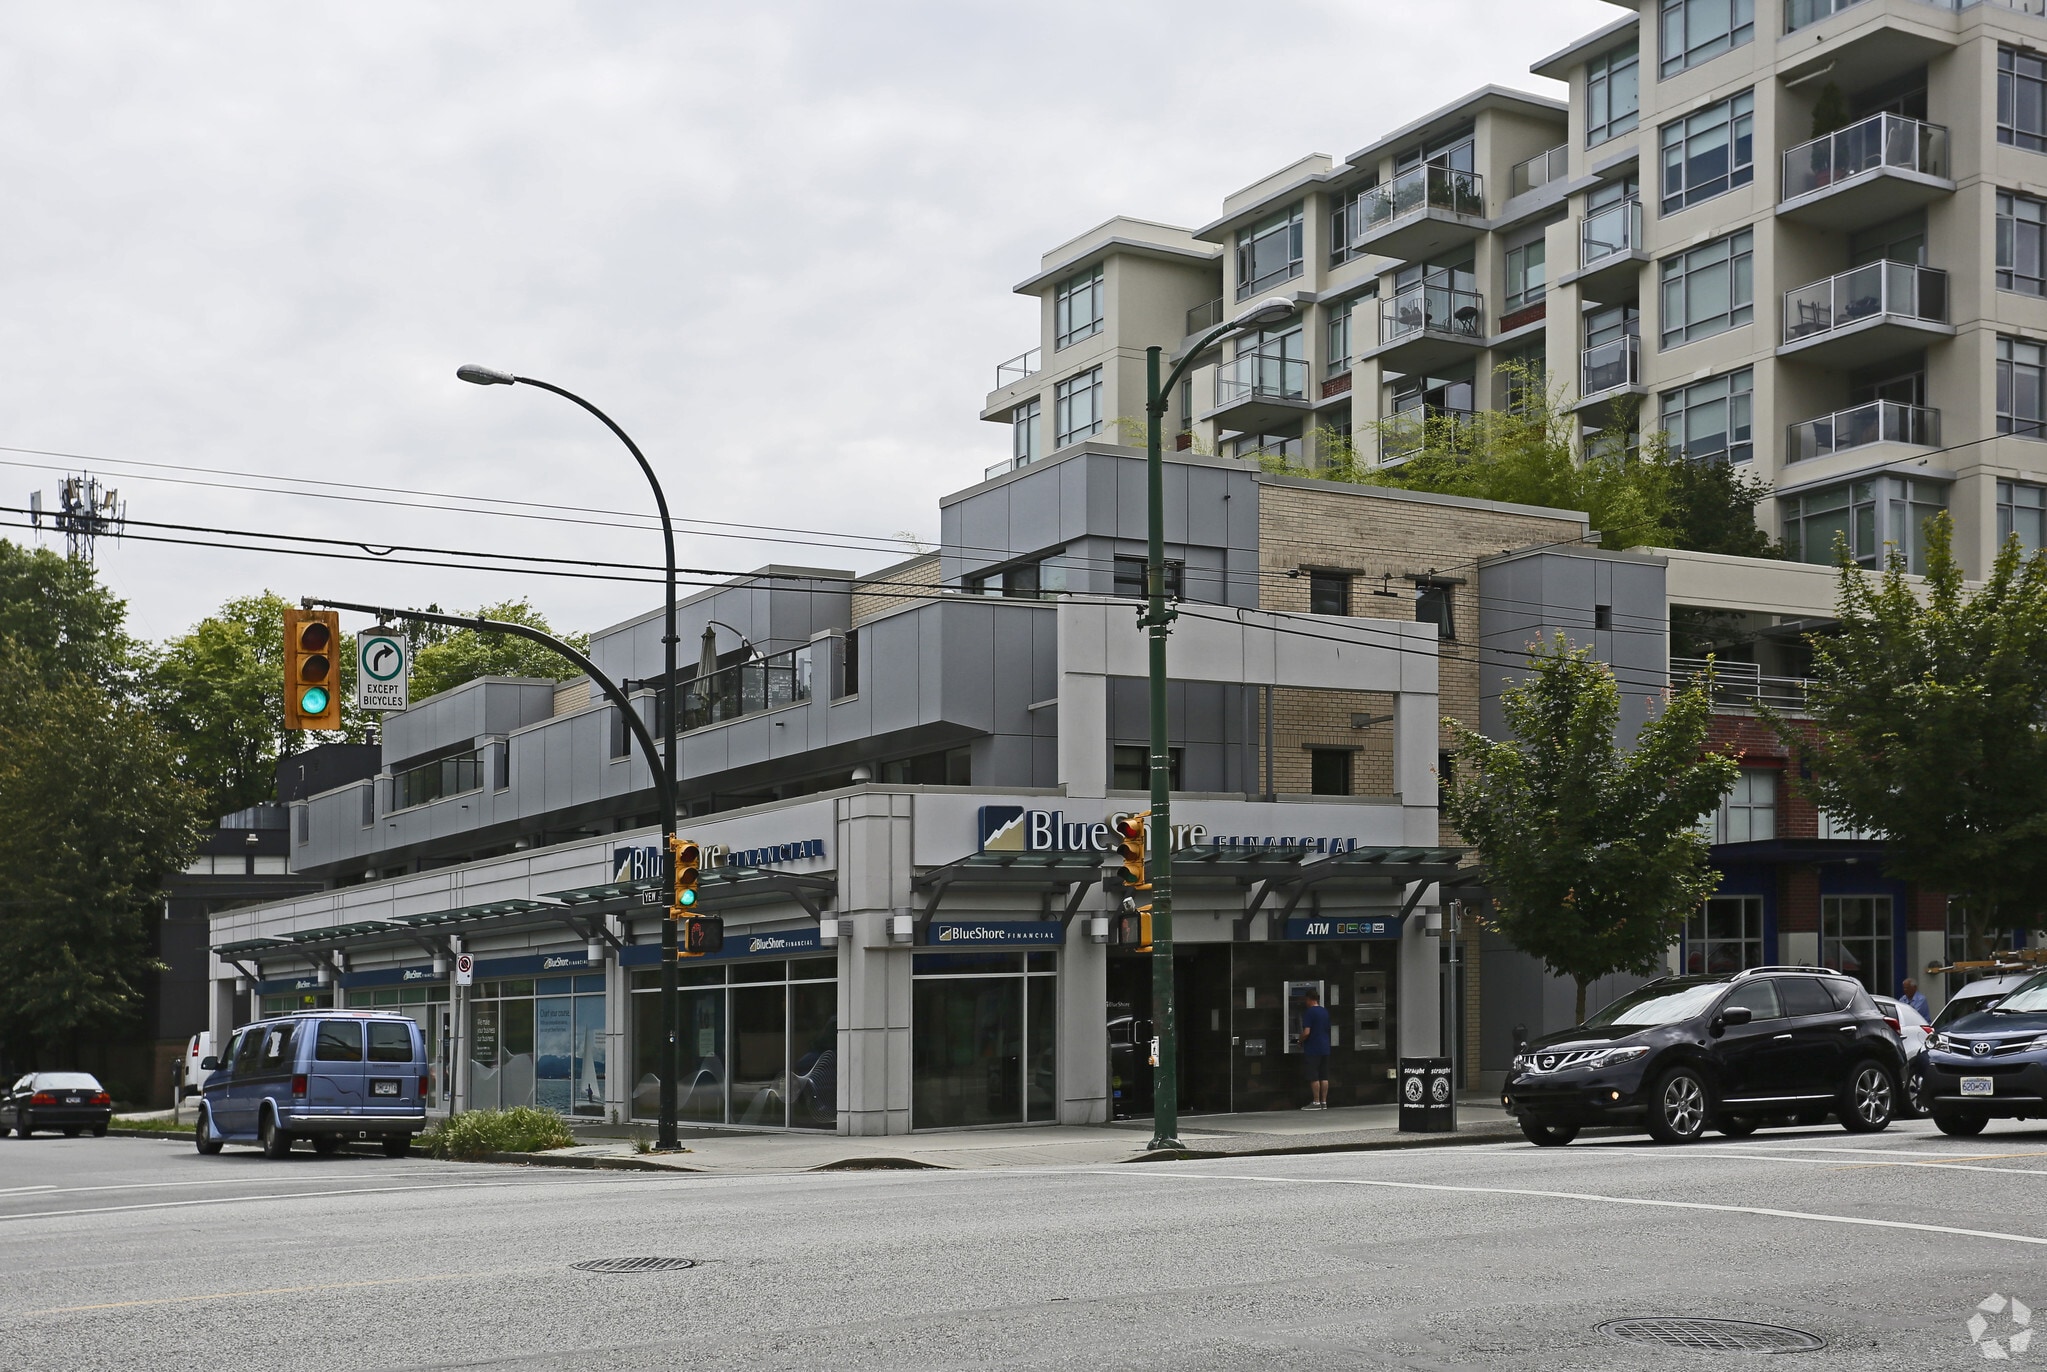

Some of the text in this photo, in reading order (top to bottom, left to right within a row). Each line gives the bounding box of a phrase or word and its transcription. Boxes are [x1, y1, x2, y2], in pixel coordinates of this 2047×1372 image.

[367, 684, 398, 694] EXCEPT
[363, 695, 403, 706] BICYCLES
[1214, 836, 1360, 853] FINANCIAL
[726, 840, 820, 866] FINANCIAL
[645, 891, 656, 902] YEW
[952, 927, 1005, 939] BlueShore
[1306, 923, 1330, 935] ATM
[756, 937, 813, 950] BlueShore FINANCIAL
